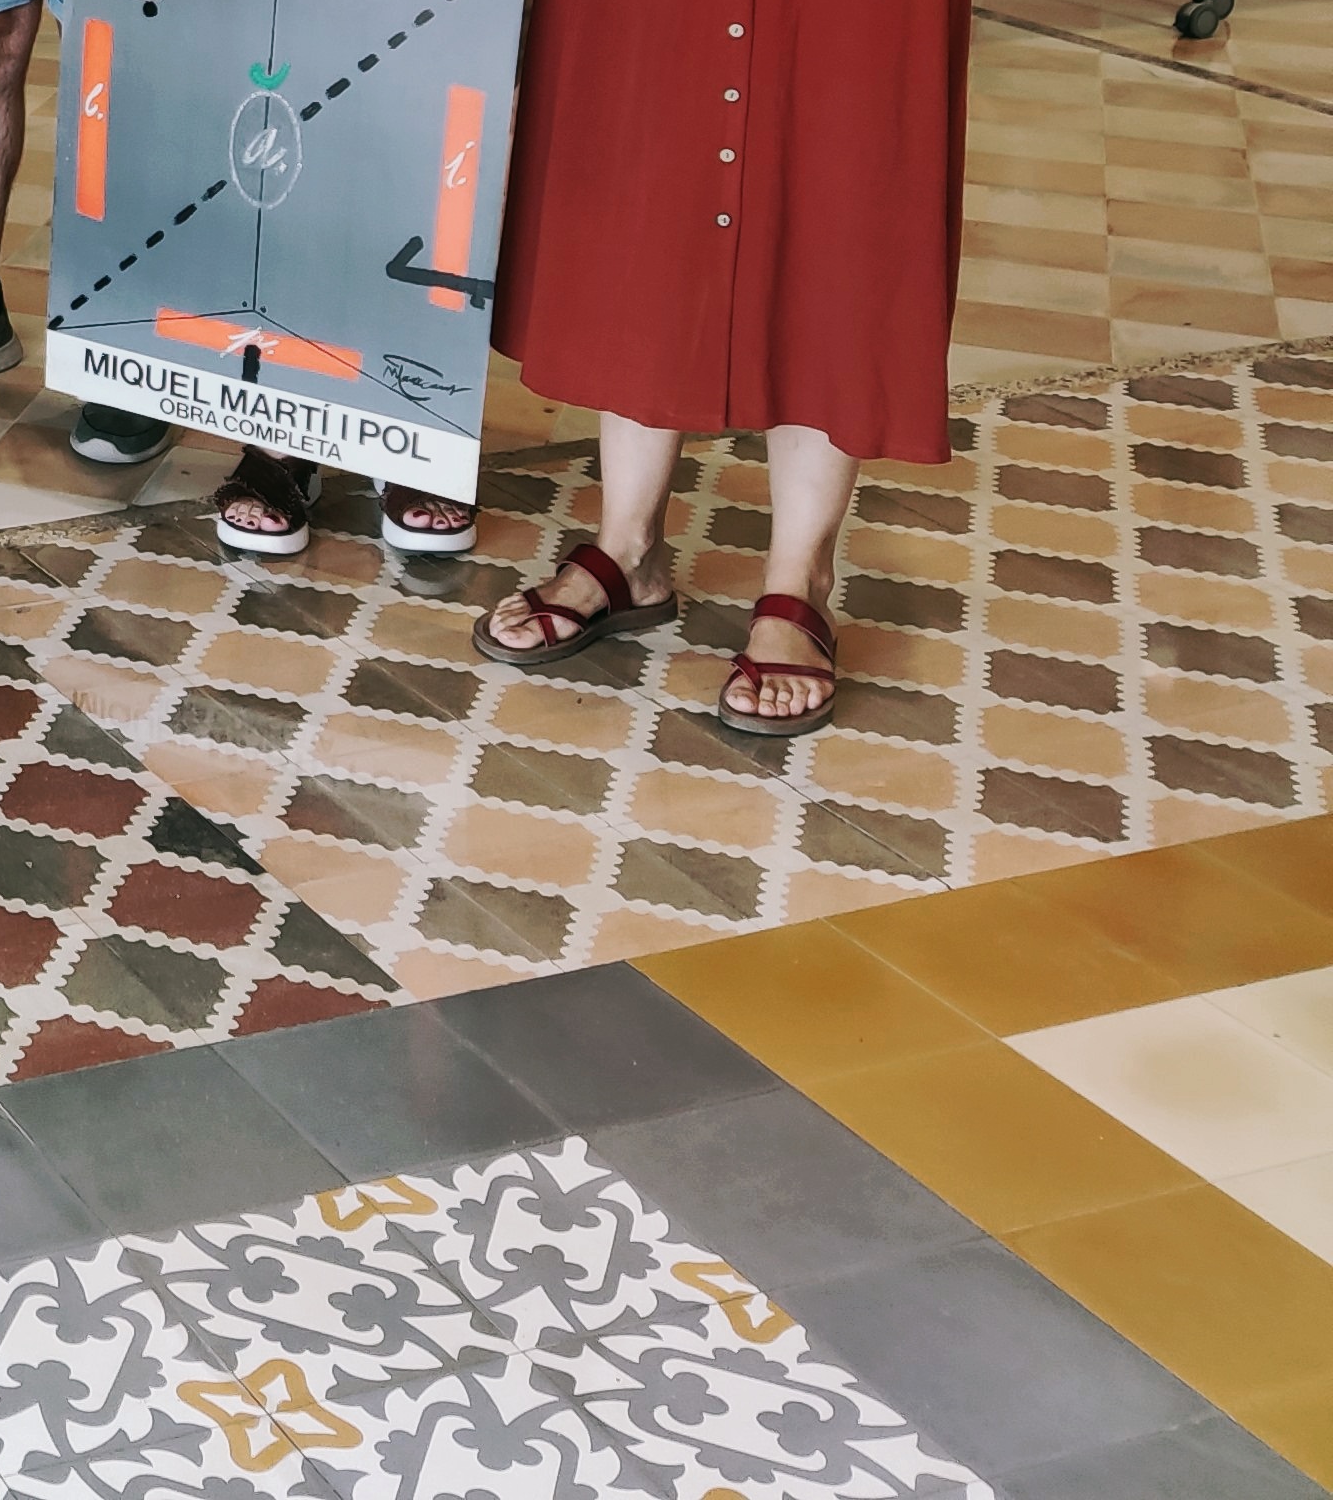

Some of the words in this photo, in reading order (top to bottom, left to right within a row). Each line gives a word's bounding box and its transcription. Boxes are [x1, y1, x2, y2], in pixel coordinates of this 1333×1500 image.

[83, 347, 212, 407] MIQUEL
[219, 384, 330, 437] MARTÍ
[340, 418, 349, 440] I
[358, 420, 432, 463] POL
[159, 397, 219, 429] OBRA
[223, 414, 343, 462] COMPLETA
